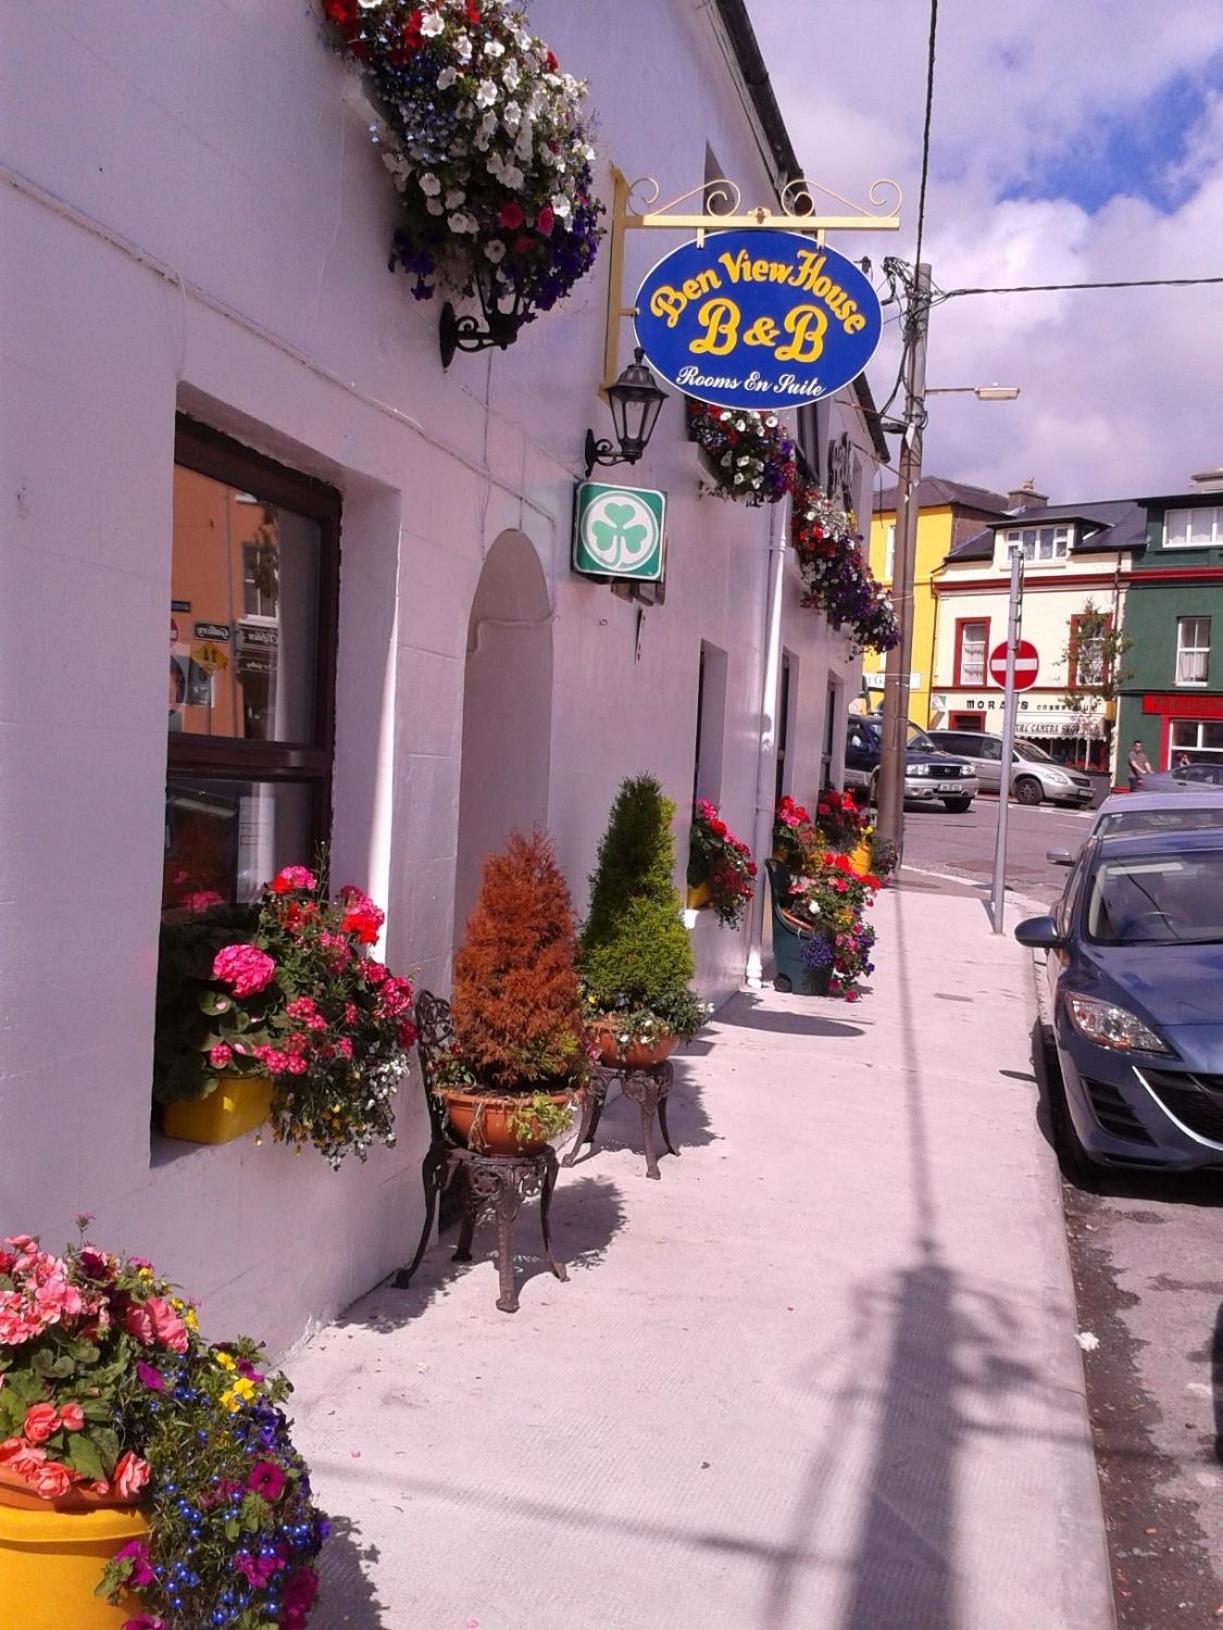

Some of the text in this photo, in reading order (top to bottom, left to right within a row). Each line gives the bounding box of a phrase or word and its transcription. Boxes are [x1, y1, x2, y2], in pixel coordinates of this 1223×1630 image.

[650, 249, 867, 335] Ben View House
[676, 365, 827, 397] Rooms En Suite
